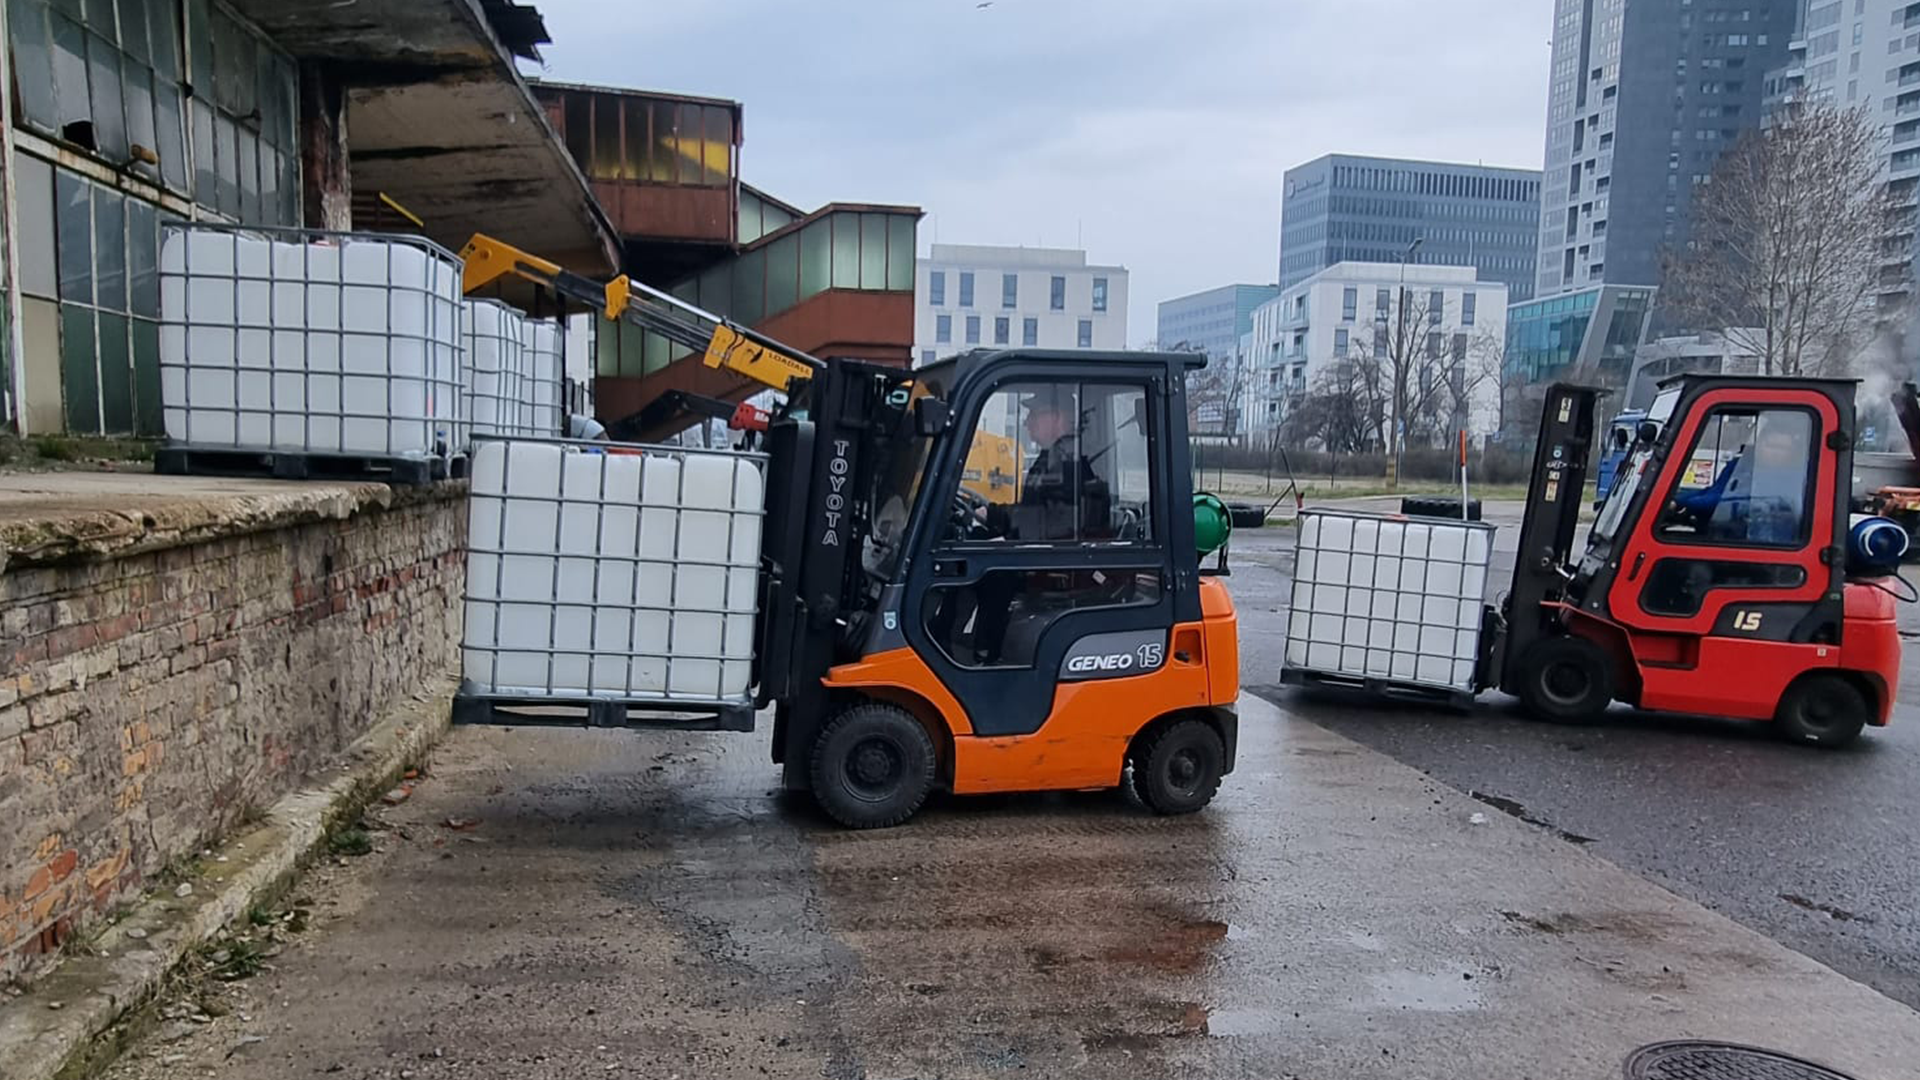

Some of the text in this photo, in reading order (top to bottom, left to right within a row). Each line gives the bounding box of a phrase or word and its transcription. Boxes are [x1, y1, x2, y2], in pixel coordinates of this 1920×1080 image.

[822, 440, 849, 546] TOYOTA
[1068, 643, 1162, 671] GENEO 15
